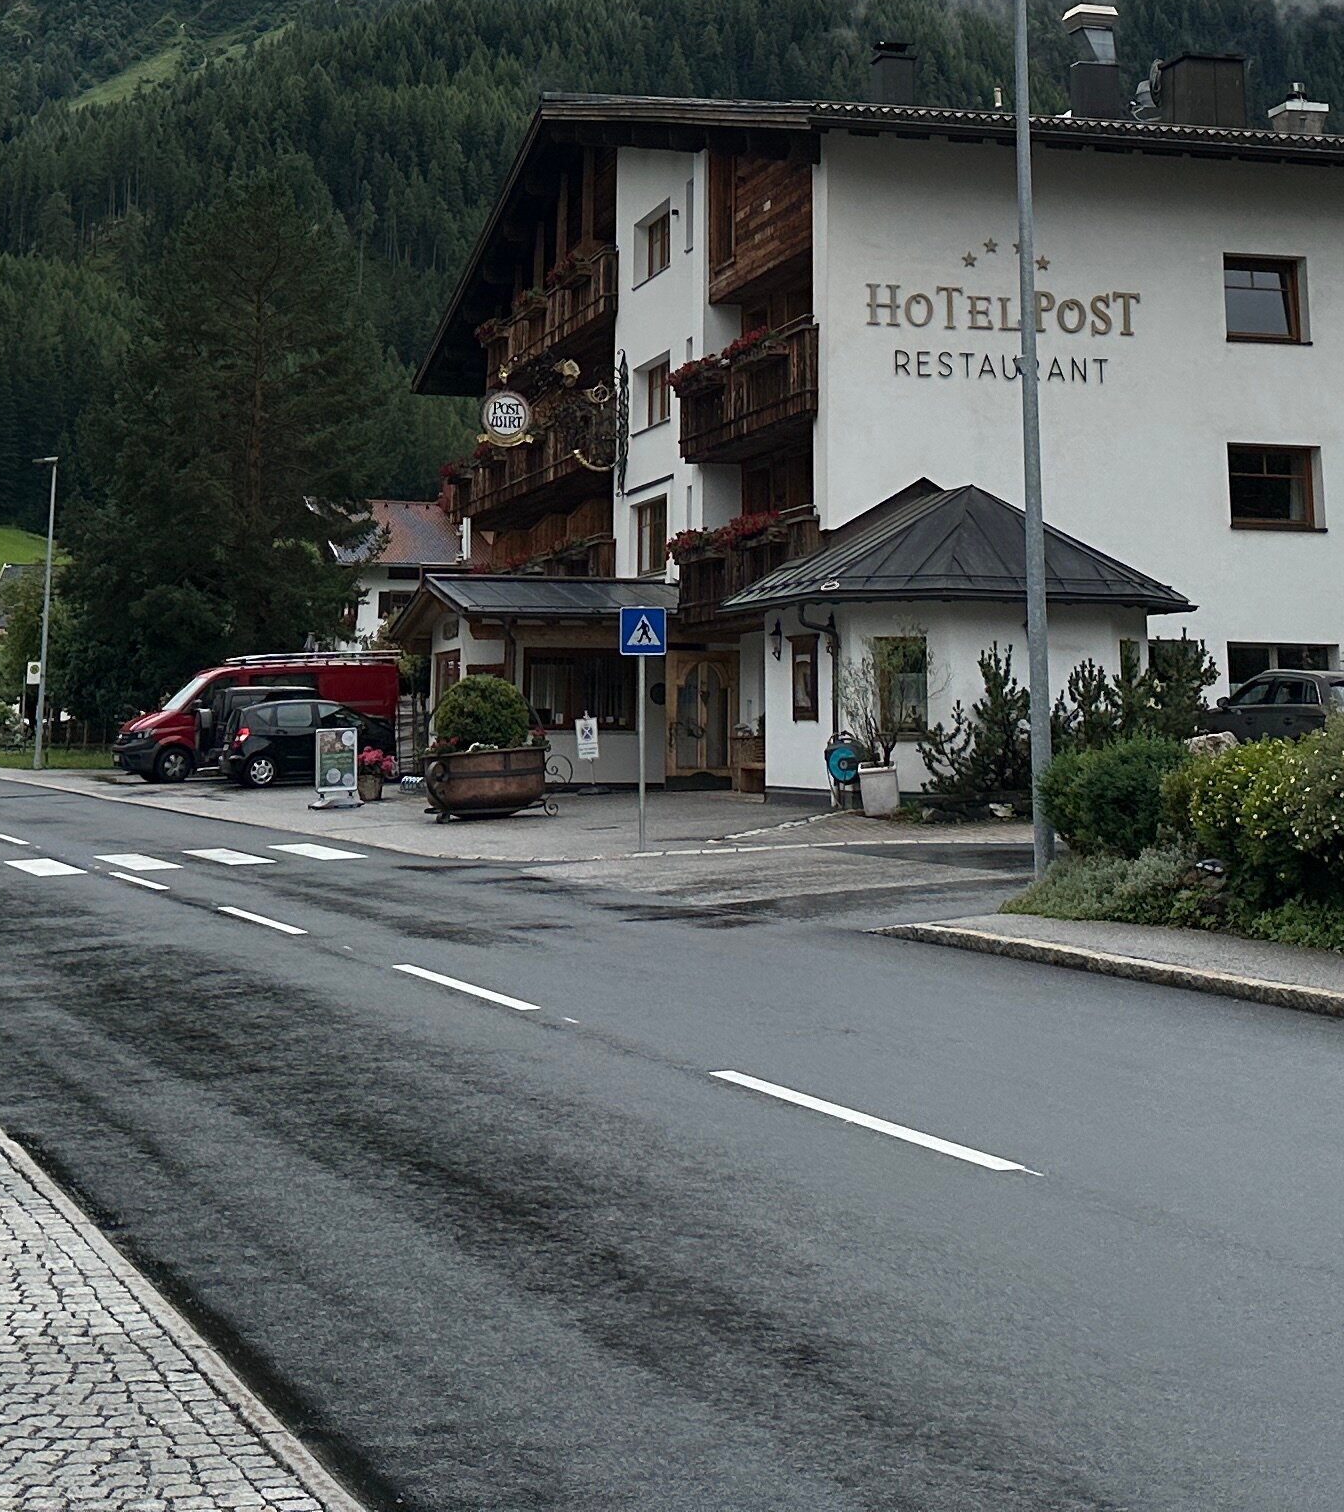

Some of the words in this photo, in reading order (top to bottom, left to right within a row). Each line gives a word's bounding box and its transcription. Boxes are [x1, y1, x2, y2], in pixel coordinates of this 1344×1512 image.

[865, 282, 1022, 331] HOTEL
[1033, 289, 1141, 337] POST
[893, 348, 1109, 384] RESTAUANT
[492, 401, 523, 415] POST
[489, 415, 523, 429] WIRT
